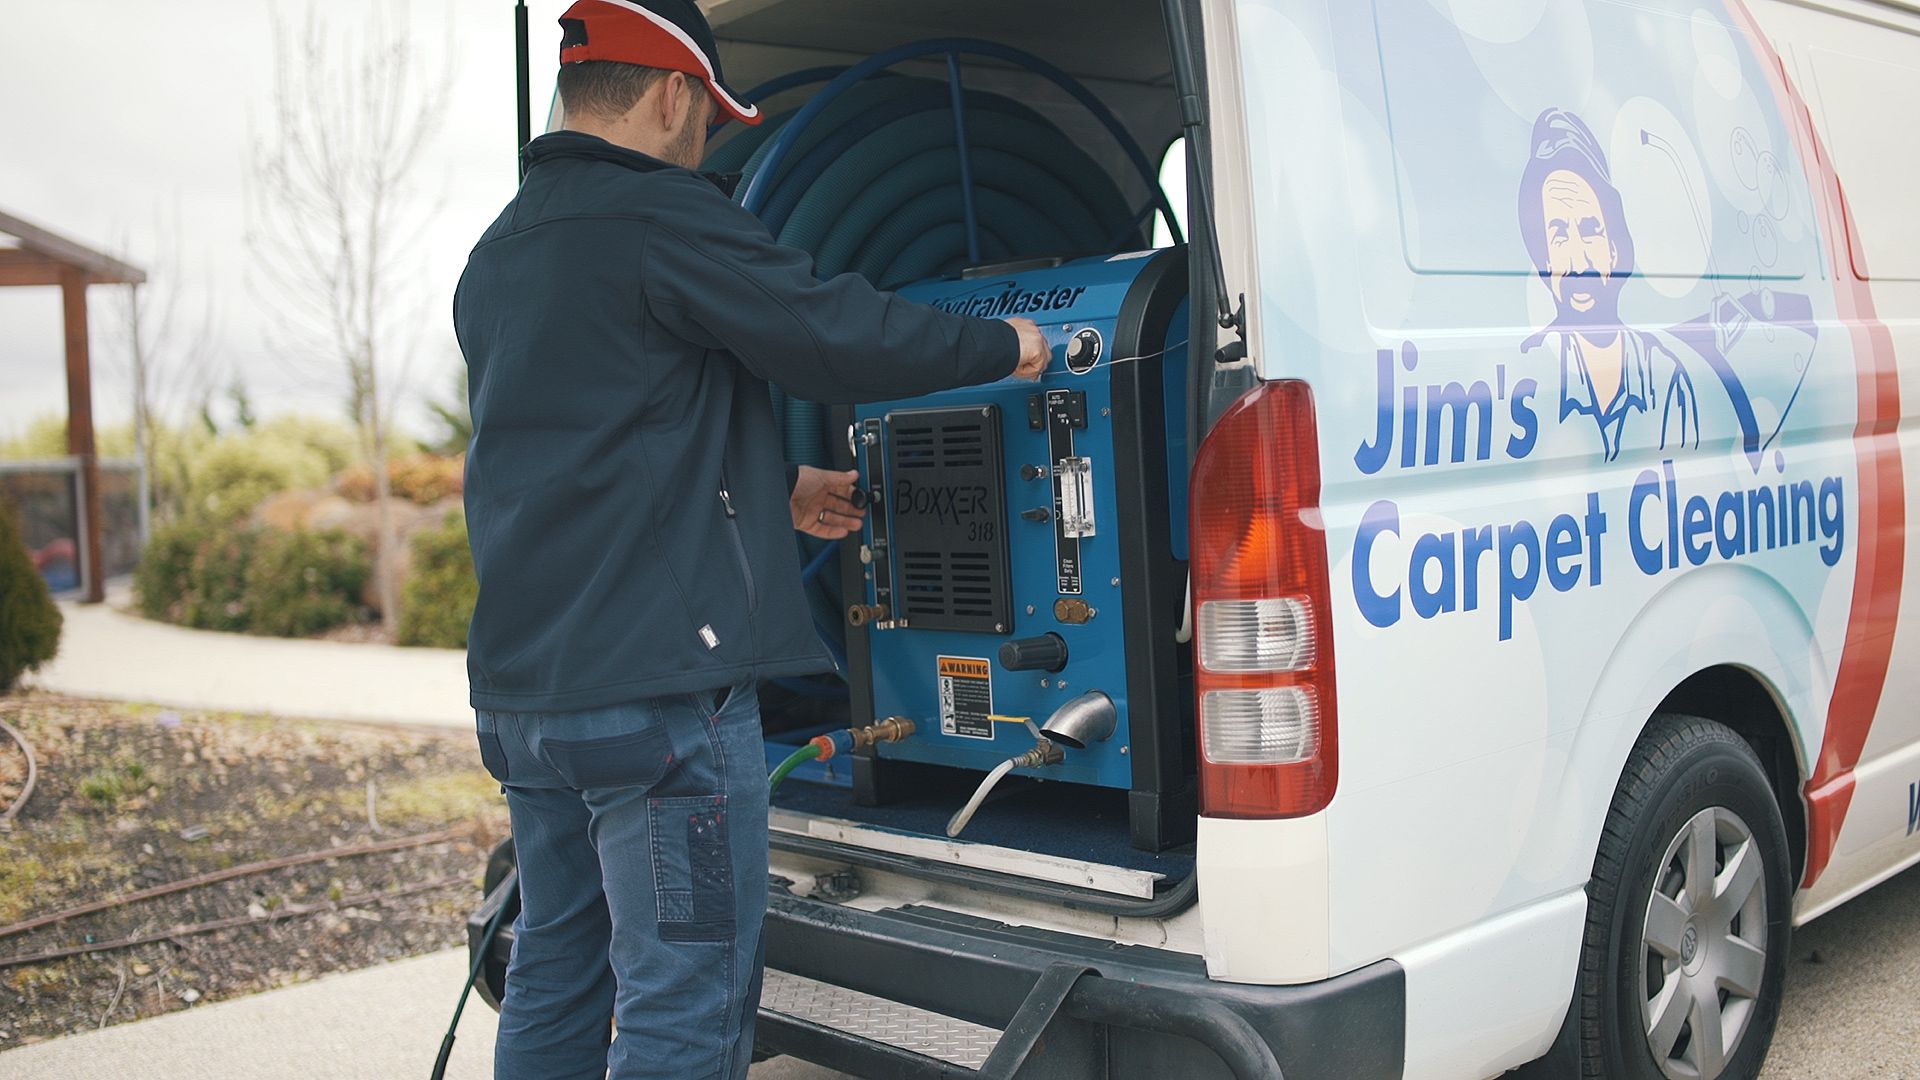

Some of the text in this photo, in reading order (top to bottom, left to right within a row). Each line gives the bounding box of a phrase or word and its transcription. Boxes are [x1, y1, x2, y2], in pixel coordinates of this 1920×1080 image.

[1353, 340, 1539, 475] Jim's
[895, 479, 988, 526] BOXXER
[967, 521, 994, 542] 318
[1352, 458, 1845, 642] Carpet Cleaning
[947, 662, 988, 675] WARNING
